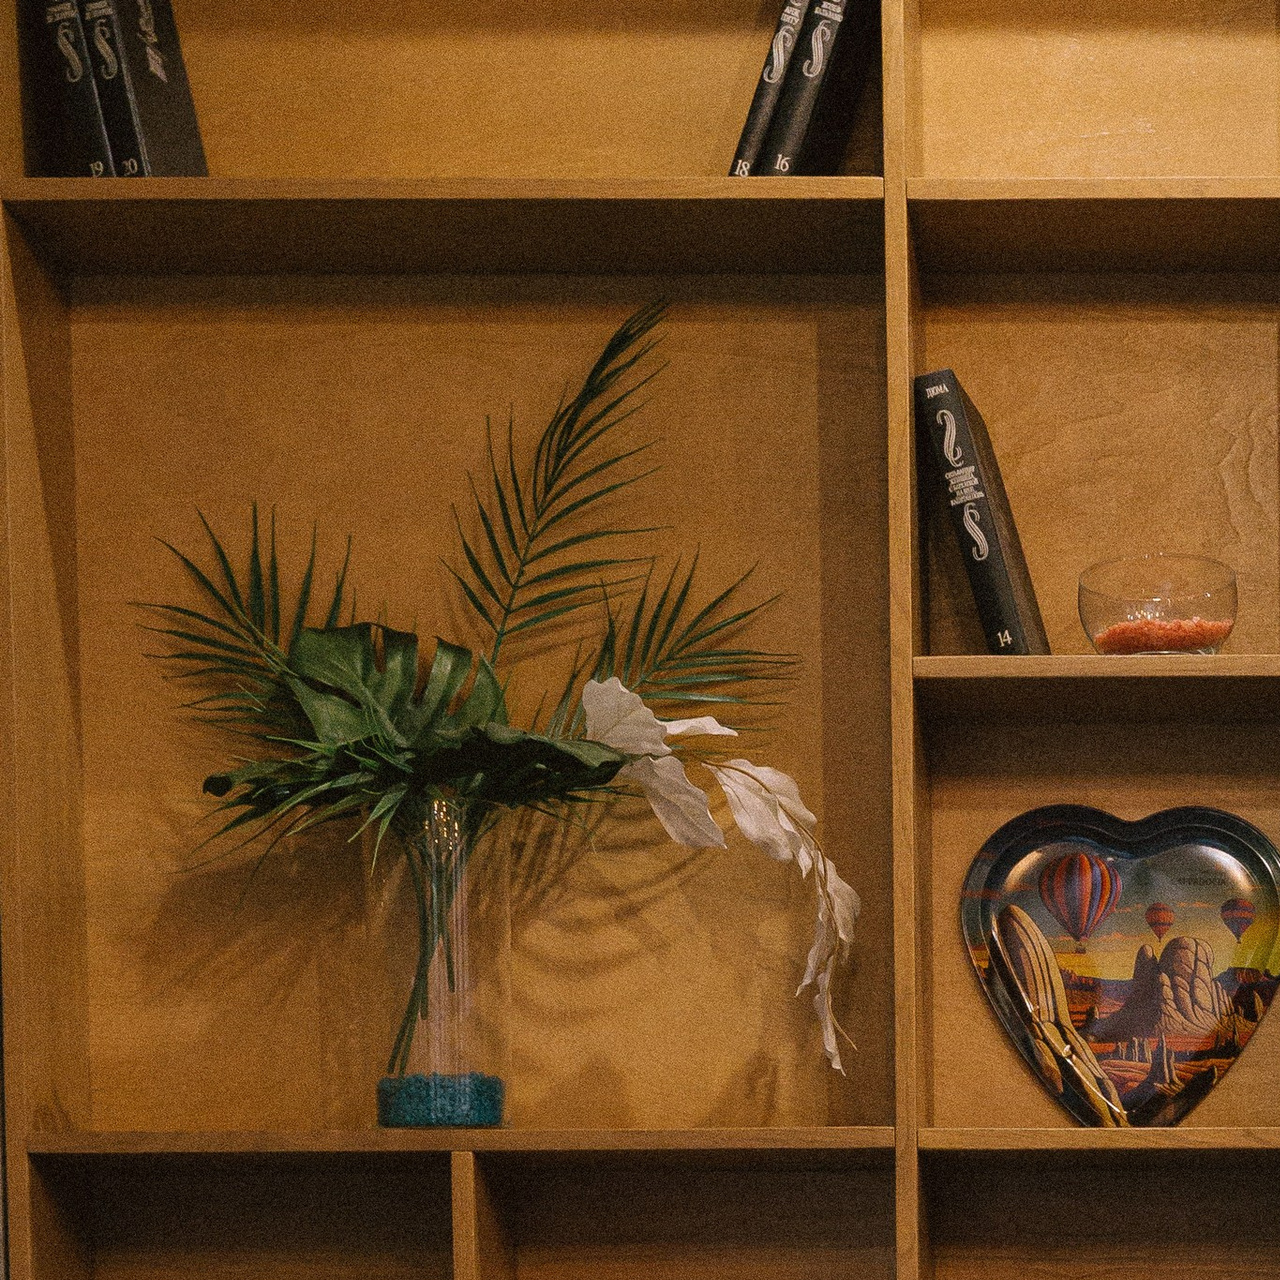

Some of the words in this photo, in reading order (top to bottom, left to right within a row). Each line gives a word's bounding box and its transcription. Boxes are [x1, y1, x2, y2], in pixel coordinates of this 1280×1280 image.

[734, 159, 750, 178] 18
[774, 154, 791, 172] 16
[925, 383, 949, 398] ДЮМА
[997, 629, 1012, 647] 14
